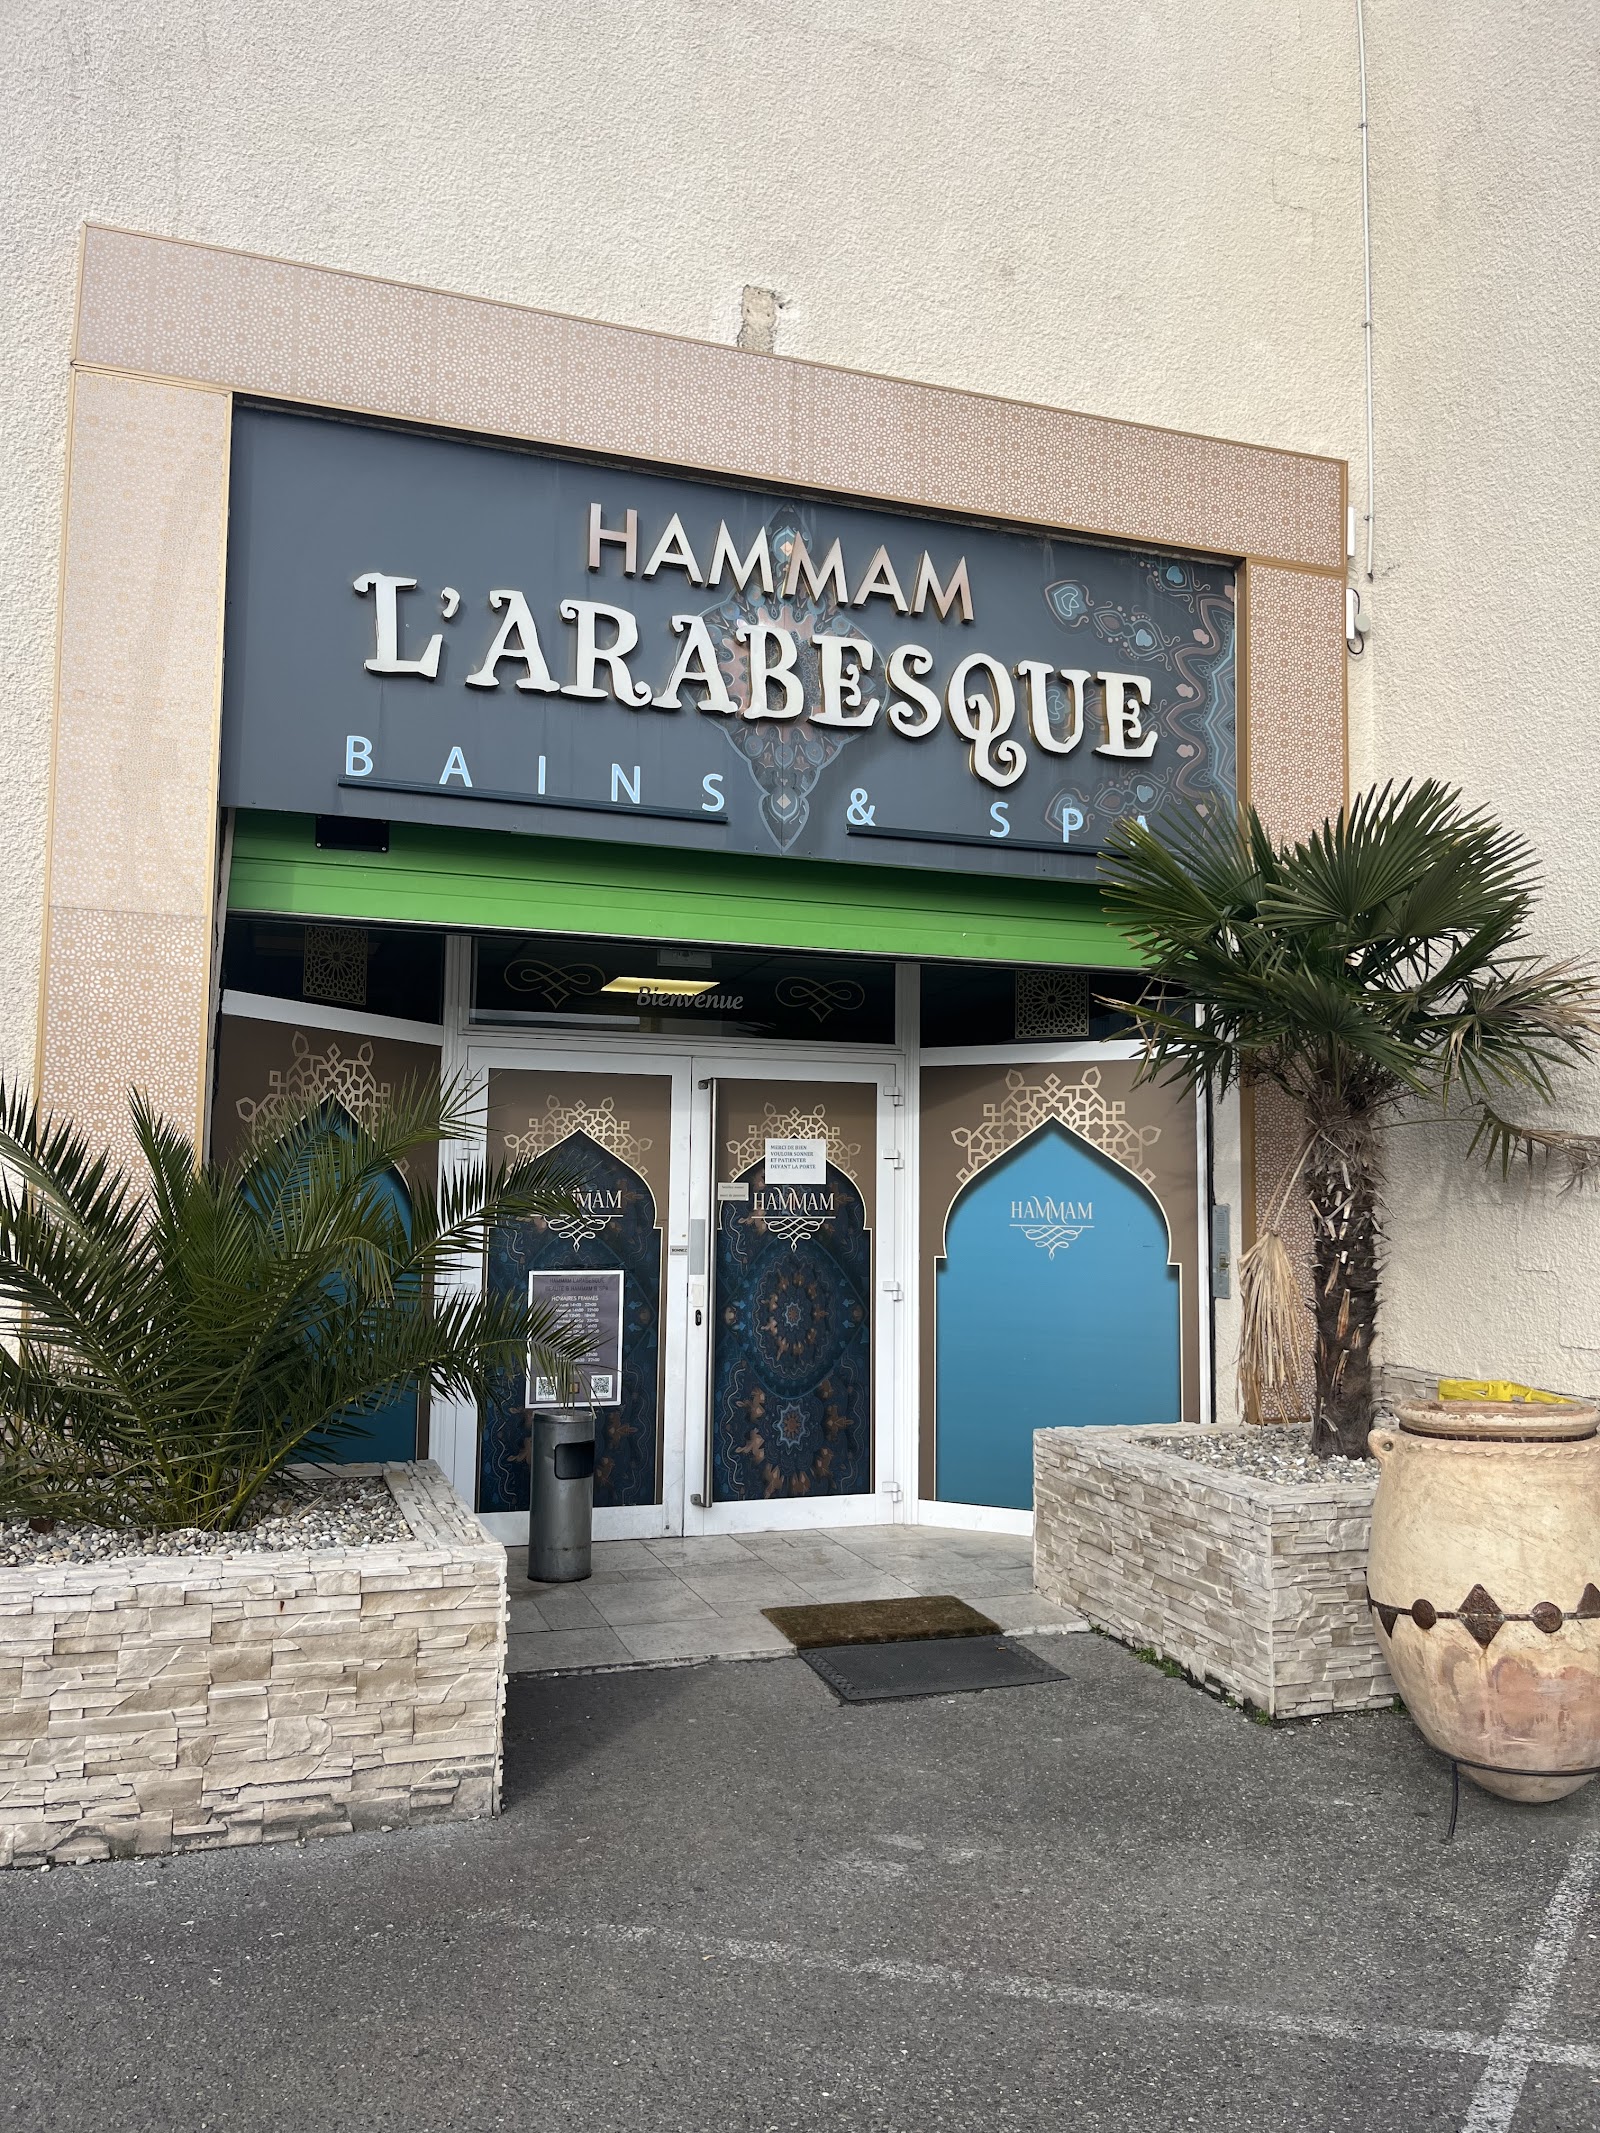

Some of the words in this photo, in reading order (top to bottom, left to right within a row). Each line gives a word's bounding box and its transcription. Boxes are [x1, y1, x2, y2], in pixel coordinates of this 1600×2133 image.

[588, 501, 974, 623] HAMMAM
[353, 571, 1159, 788] L'ARABESQUE
[345, 734, 725, 813] BAINS
[847, 787, 877, 827] &
[636, 986, 744, 1010] Bienvenue
[753, 1186, 835, 1216] HAMMAM
[1010, 1195, 1094, 1225] HAMMAM
